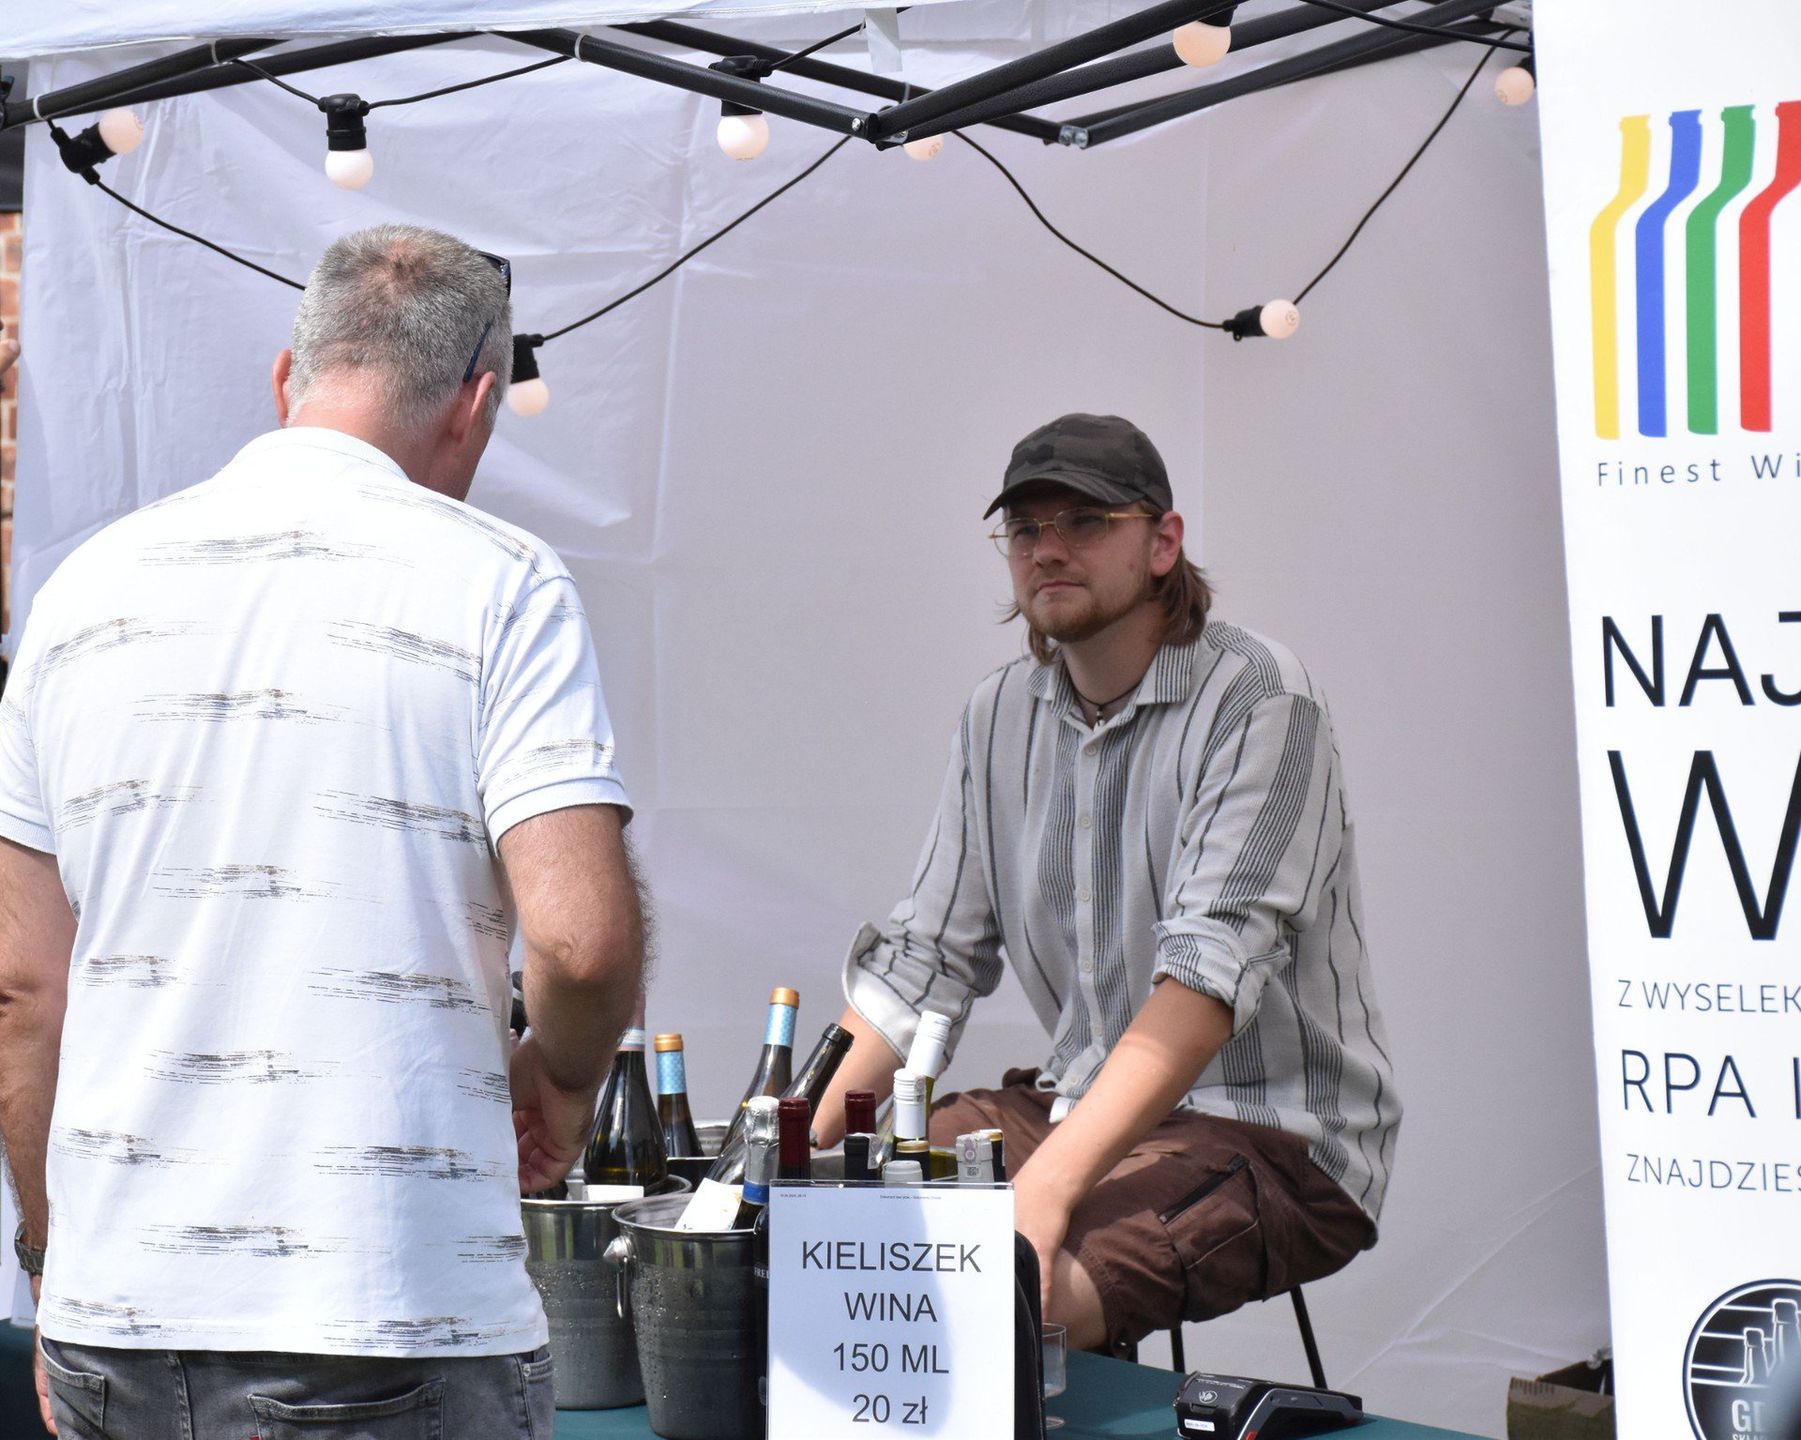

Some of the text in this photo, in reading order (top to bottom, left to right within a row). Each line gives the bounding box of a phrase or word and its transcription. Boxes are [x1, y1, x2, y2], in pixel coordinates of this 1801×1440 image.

[1597, 459, 1721, 487] Finest
[1618, 979, 1801, 1013] Z WYSELEK
[1621, 1049, 1757, 1119] RPA
[1626, 1153, 1801, 1193] ZNAJDZIE
[802, 1241, 982, 1273] KIELISZEK
[844, 1292, 938, 1322] WINA
[833, 1343, 949, 1374] 150 ML
[852, 1394, 928, 1424] 20 zł
